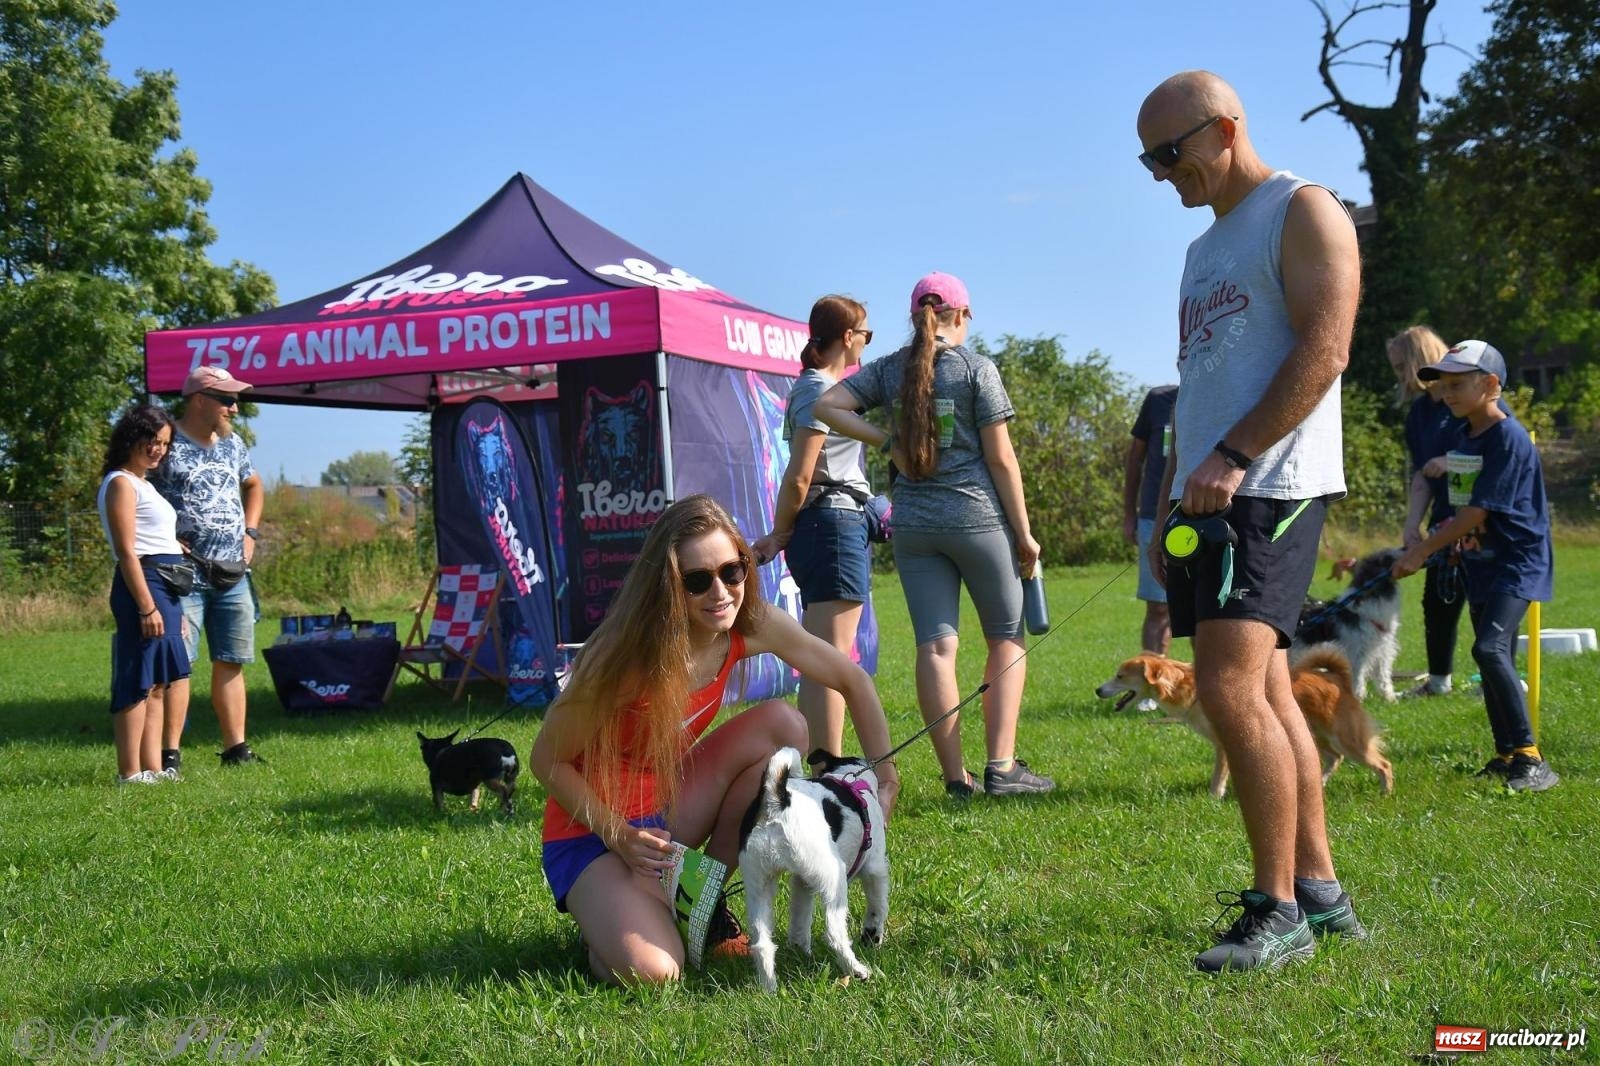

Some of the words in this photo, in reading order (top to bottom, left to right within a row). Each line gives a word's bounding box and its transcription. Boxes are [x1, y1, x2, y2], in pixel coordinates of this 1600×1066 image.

[325, 265, 568, 308] Ibero
[186, 335, 266, 374] 75%
[277, 320, 428, 368] ANIMAL
[439, 302, 611, 354] PROTEIN
[723, 314, 763, 356] LOW
[577, 480, 666, 519] Ibero
